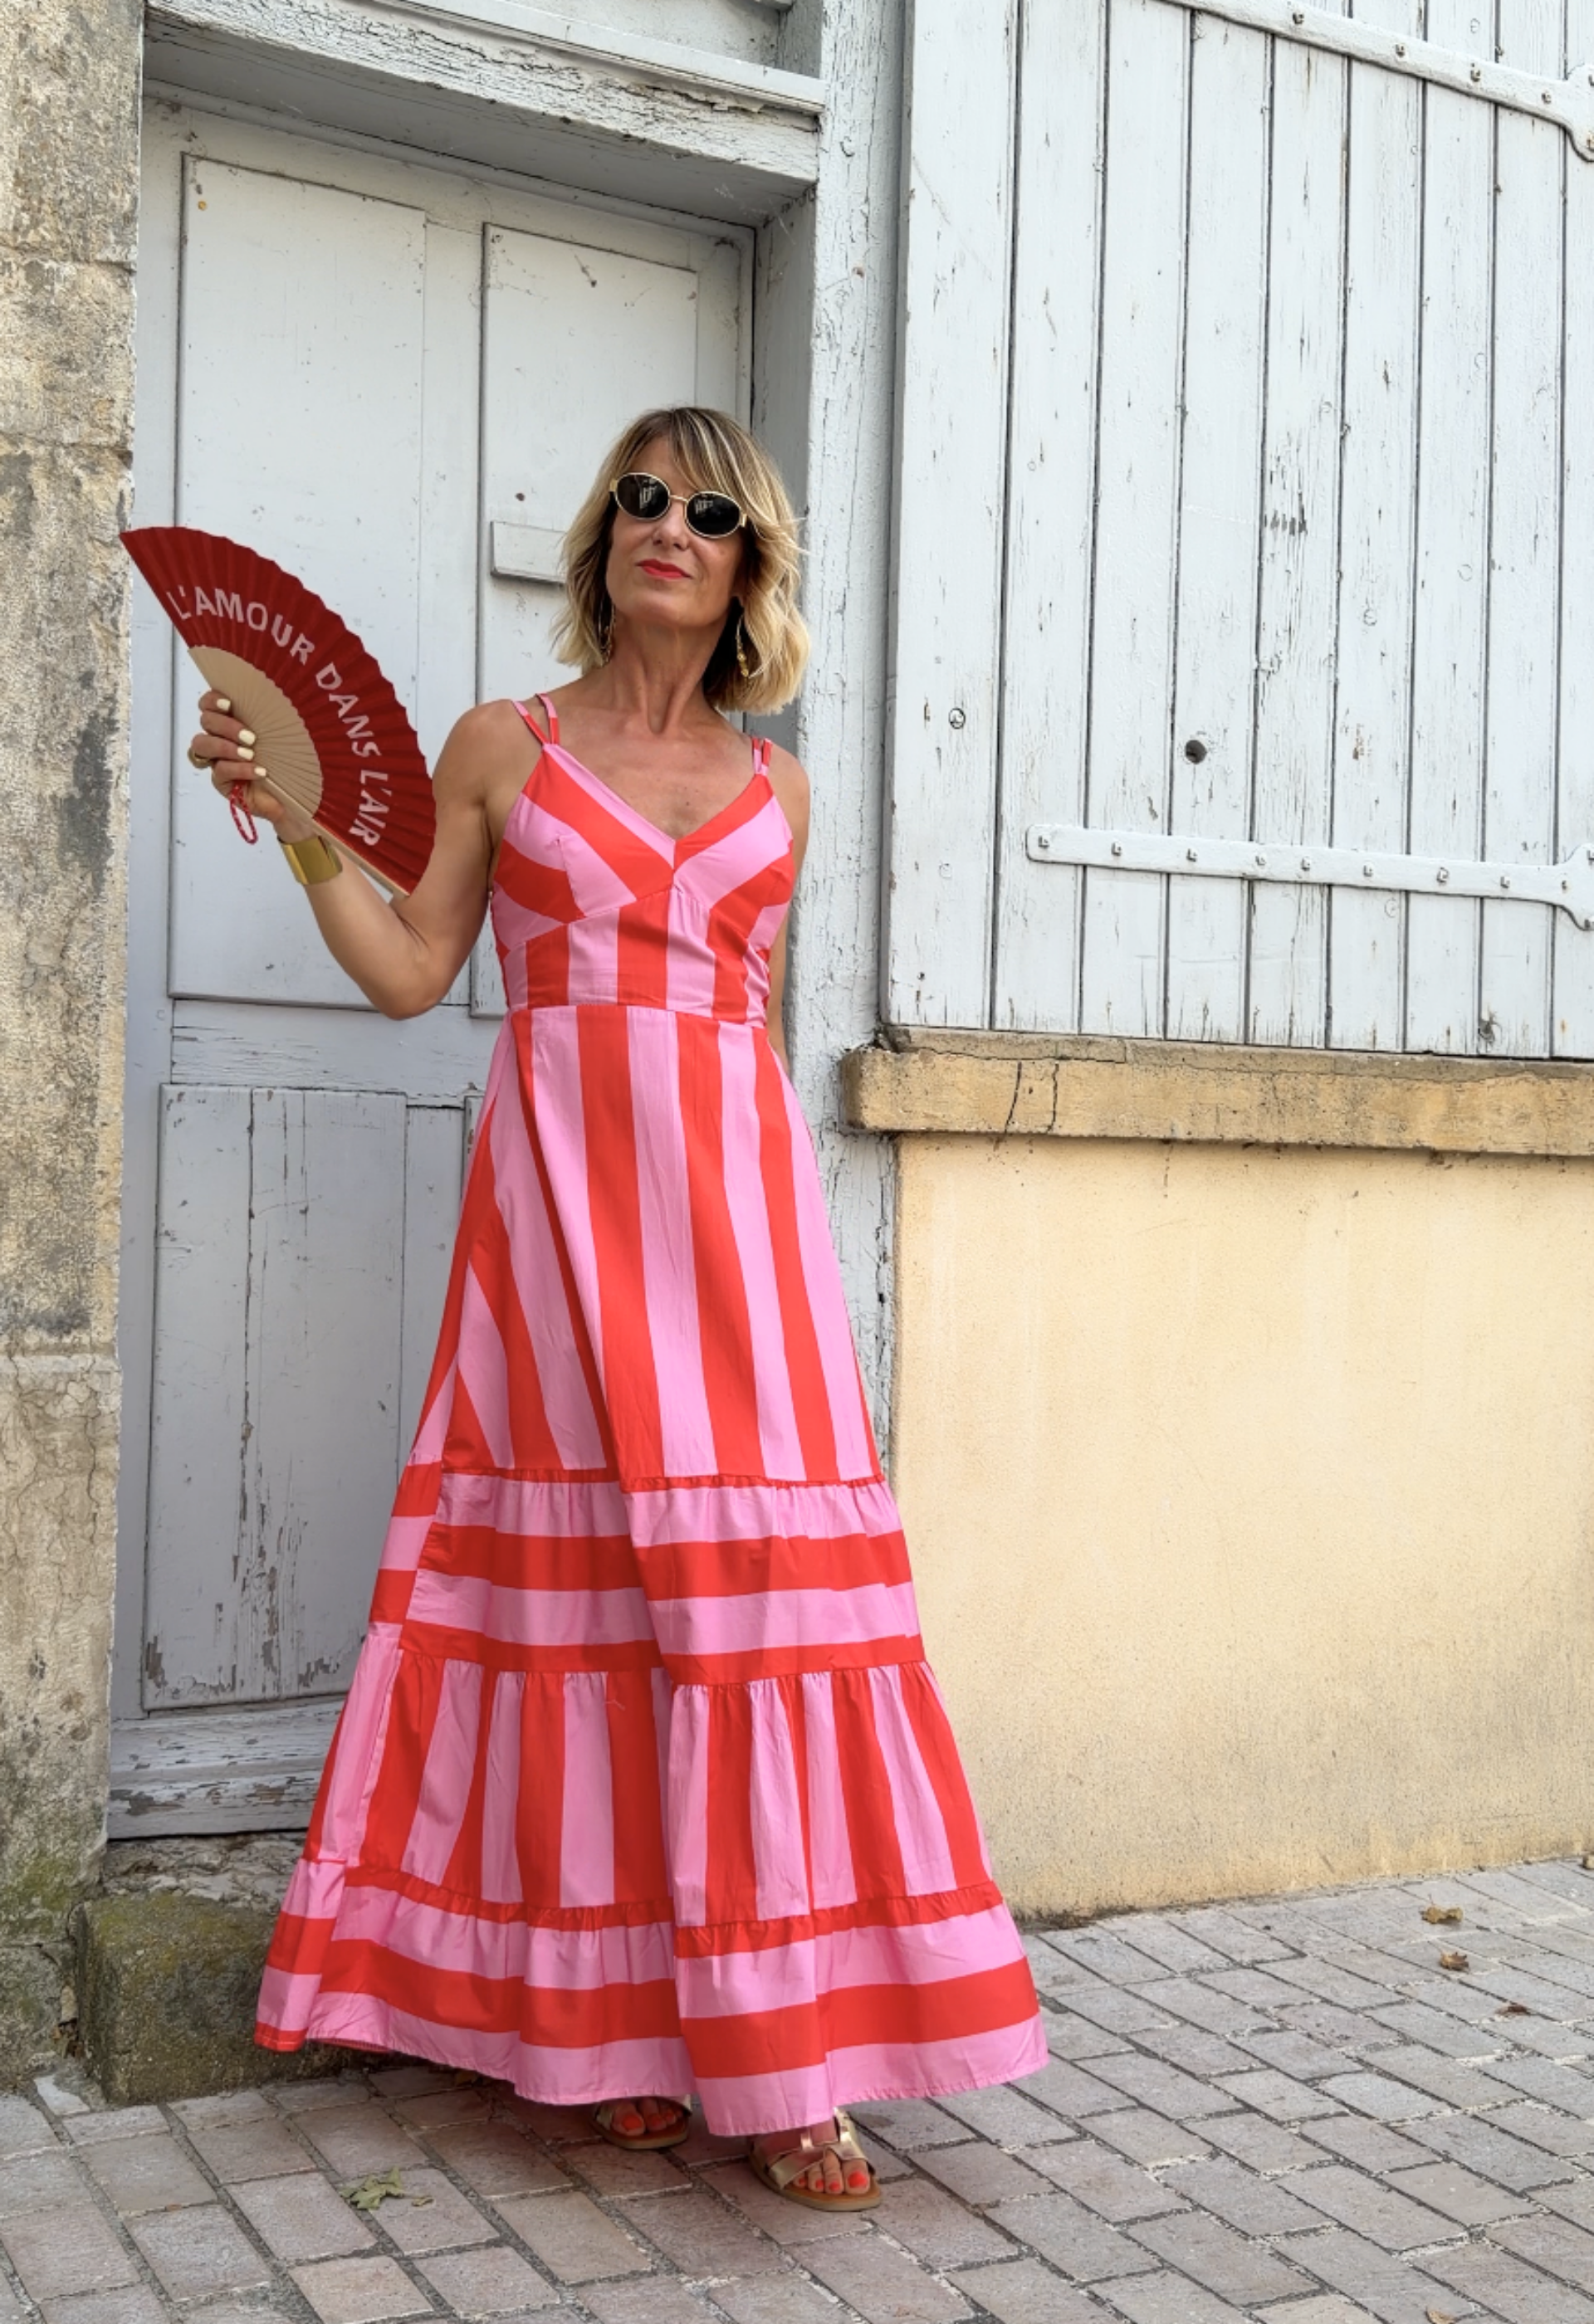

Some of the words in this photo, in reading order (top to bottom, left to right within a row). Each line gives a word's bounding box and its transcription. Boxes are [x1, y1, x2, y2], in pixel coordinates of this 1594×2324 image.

[166, 585, 315, 664] L'AMOUR
[315, 663, 382, 759] DANS
[349, 769, 393, 847] L'AIR
